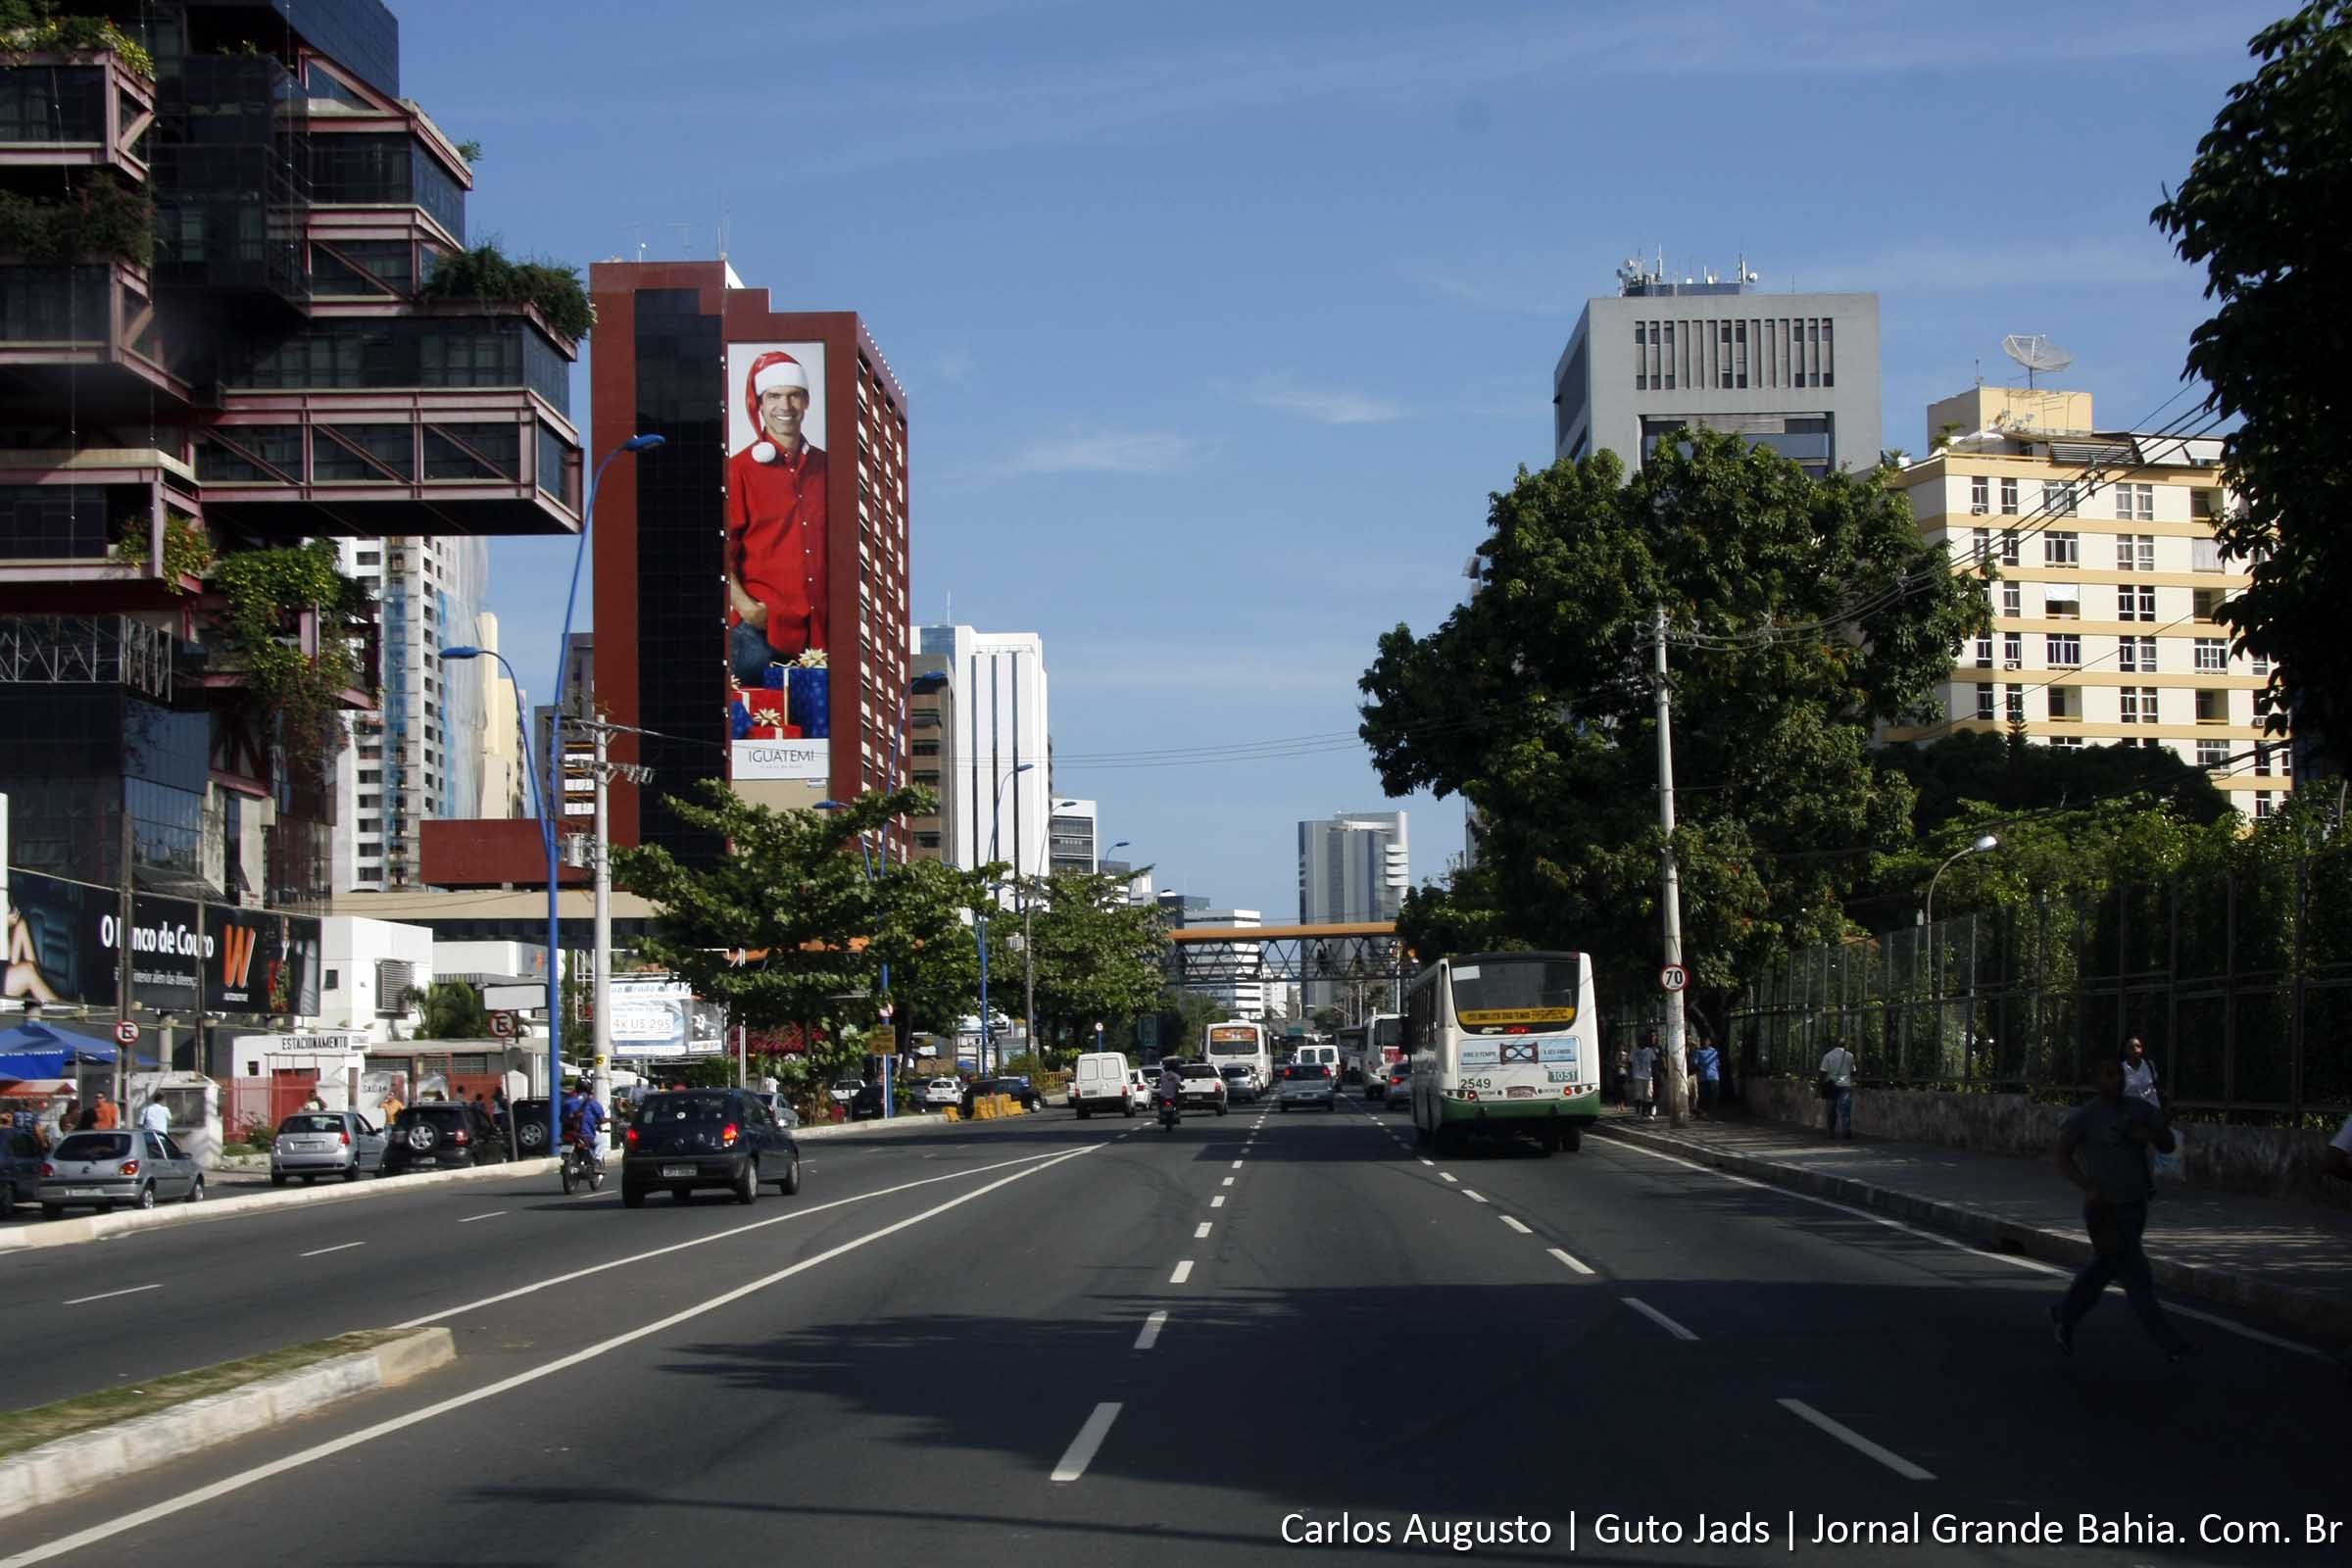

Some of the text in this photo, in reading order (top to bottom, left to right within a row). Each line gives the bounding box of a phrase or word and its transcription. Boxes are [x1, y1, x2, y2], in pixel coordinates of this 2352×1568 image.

[749, 749, 814, 762] IGUATEMI
[116, 916, 157, 952] nco
[158, 920, 174, 954] de
[1666, 970, 1684, 986] 70
[282, 1036, 348, 1050] ESTACIONAMENTO
[1460, 1078, 1492, 1090] 2549
